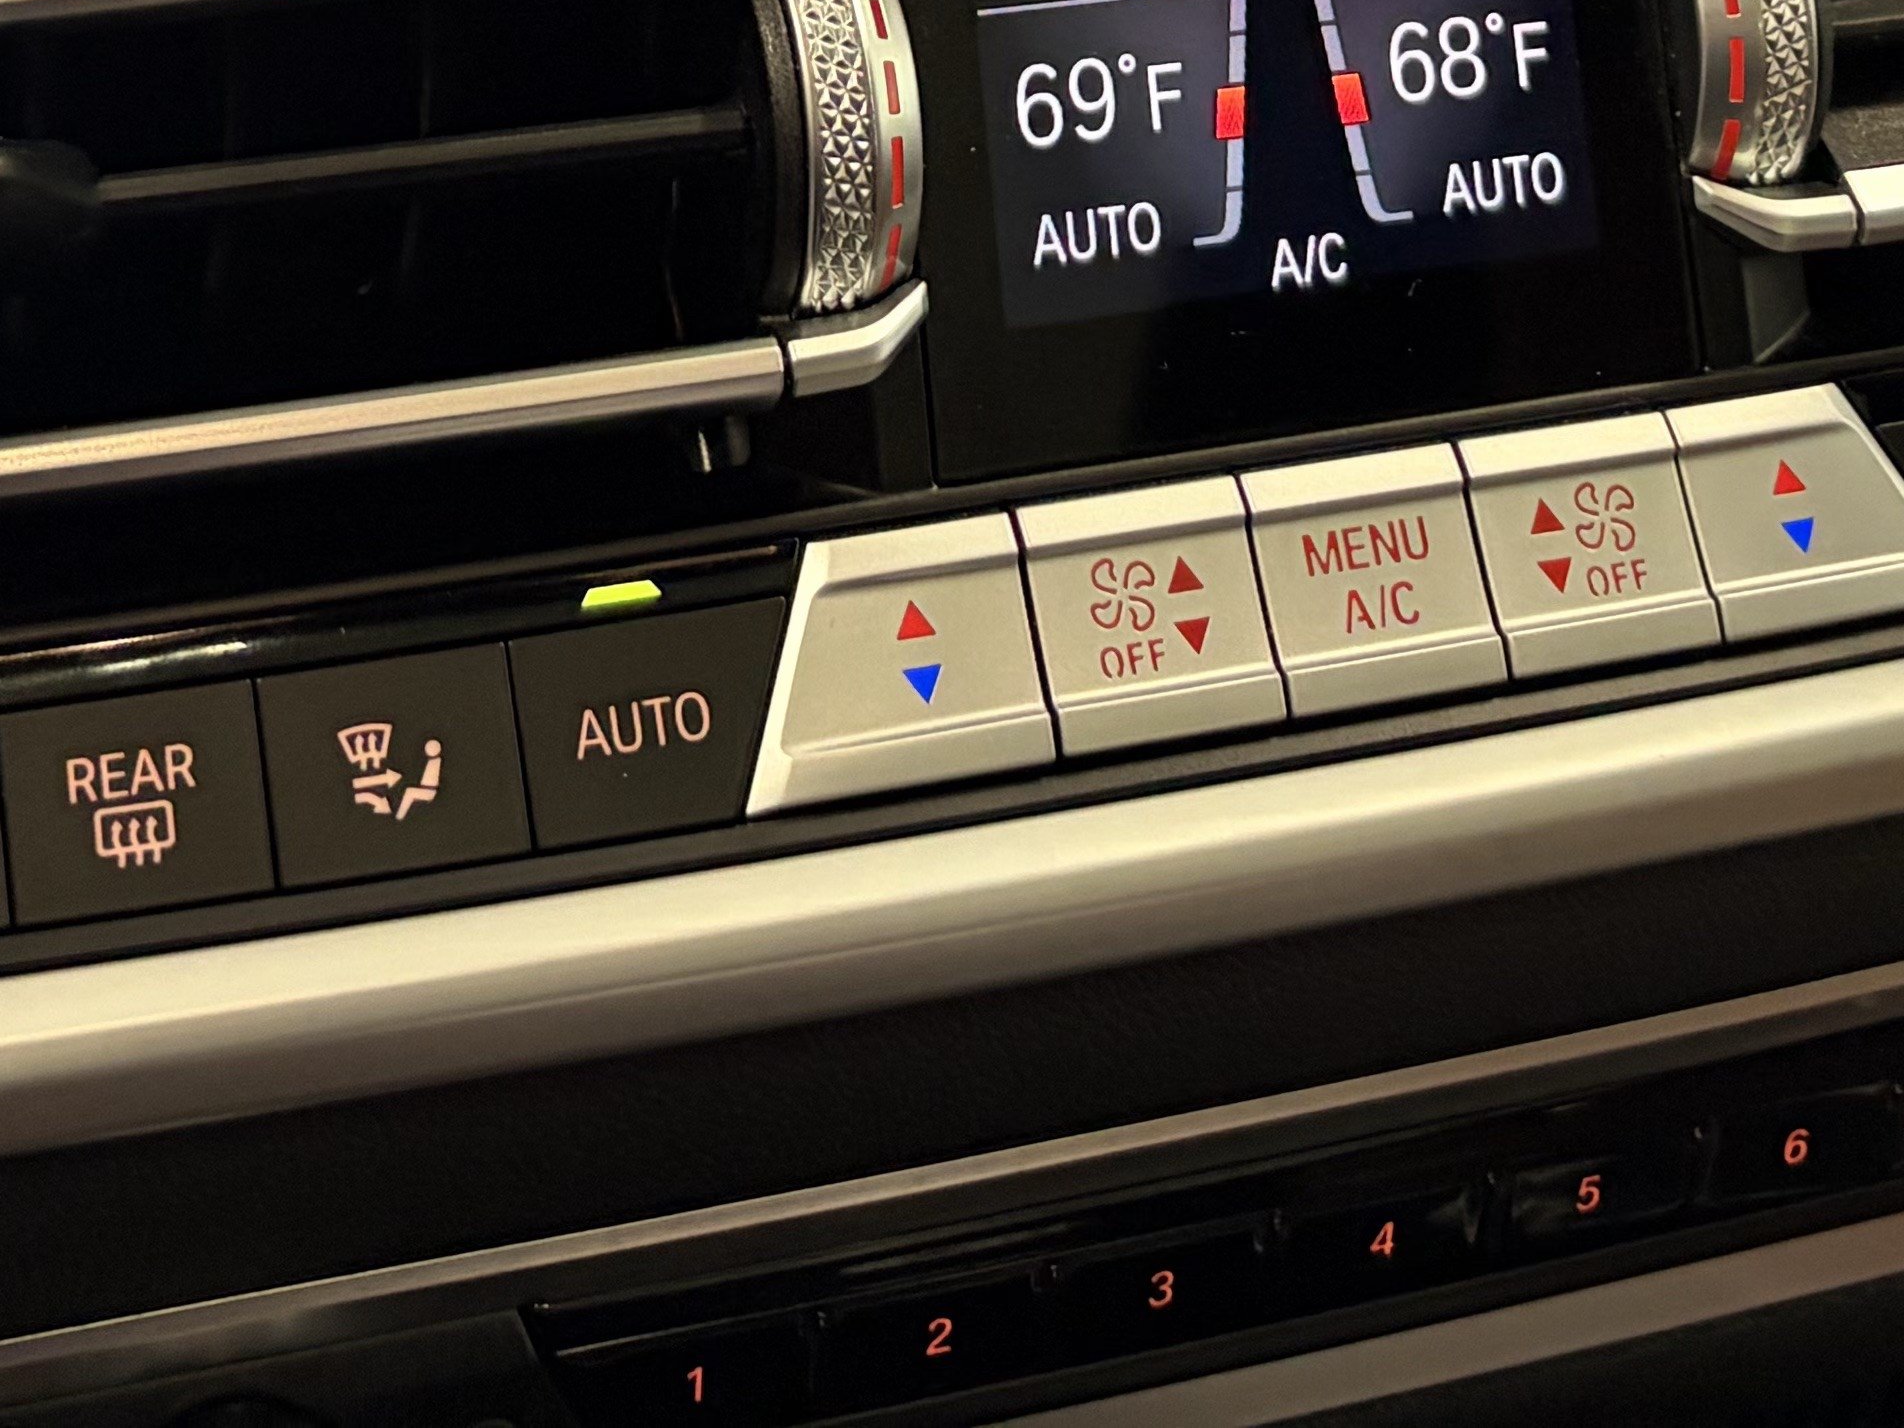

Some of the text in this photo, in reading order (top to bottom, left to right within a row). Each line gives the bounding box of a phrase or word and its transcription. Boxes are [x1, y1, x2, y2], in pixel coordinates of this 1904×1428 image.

[1389, 12, 1547, 103] 68°F
[1016, 53, 1182, 147] 69°F
[1443, 151, 1564, 214] AUTO
[1033, 201, 1161, 266] AUTO
[1271, 232, 1347, 288] A/C
[1302, 517, 1429, 575] MENU
[1587, 556, 1648, 598] OFF
[1346, 581, 1420, 630] A/C
[1100, 636, 1166, 679] OFF
[577, 691, 710, 760] AUTO
[66, 743, 196, 802] REAR
[1784, 1128, 1808, 1165] 6
[1578, 1175, 1601, 1213] 5
[1371, 1223, 1394, 1256] 4
[1149, 1270, 1174, 1308] 3
[927, 1317, 953, 1357] 2
[689, 1367, 703, 1401] 1
